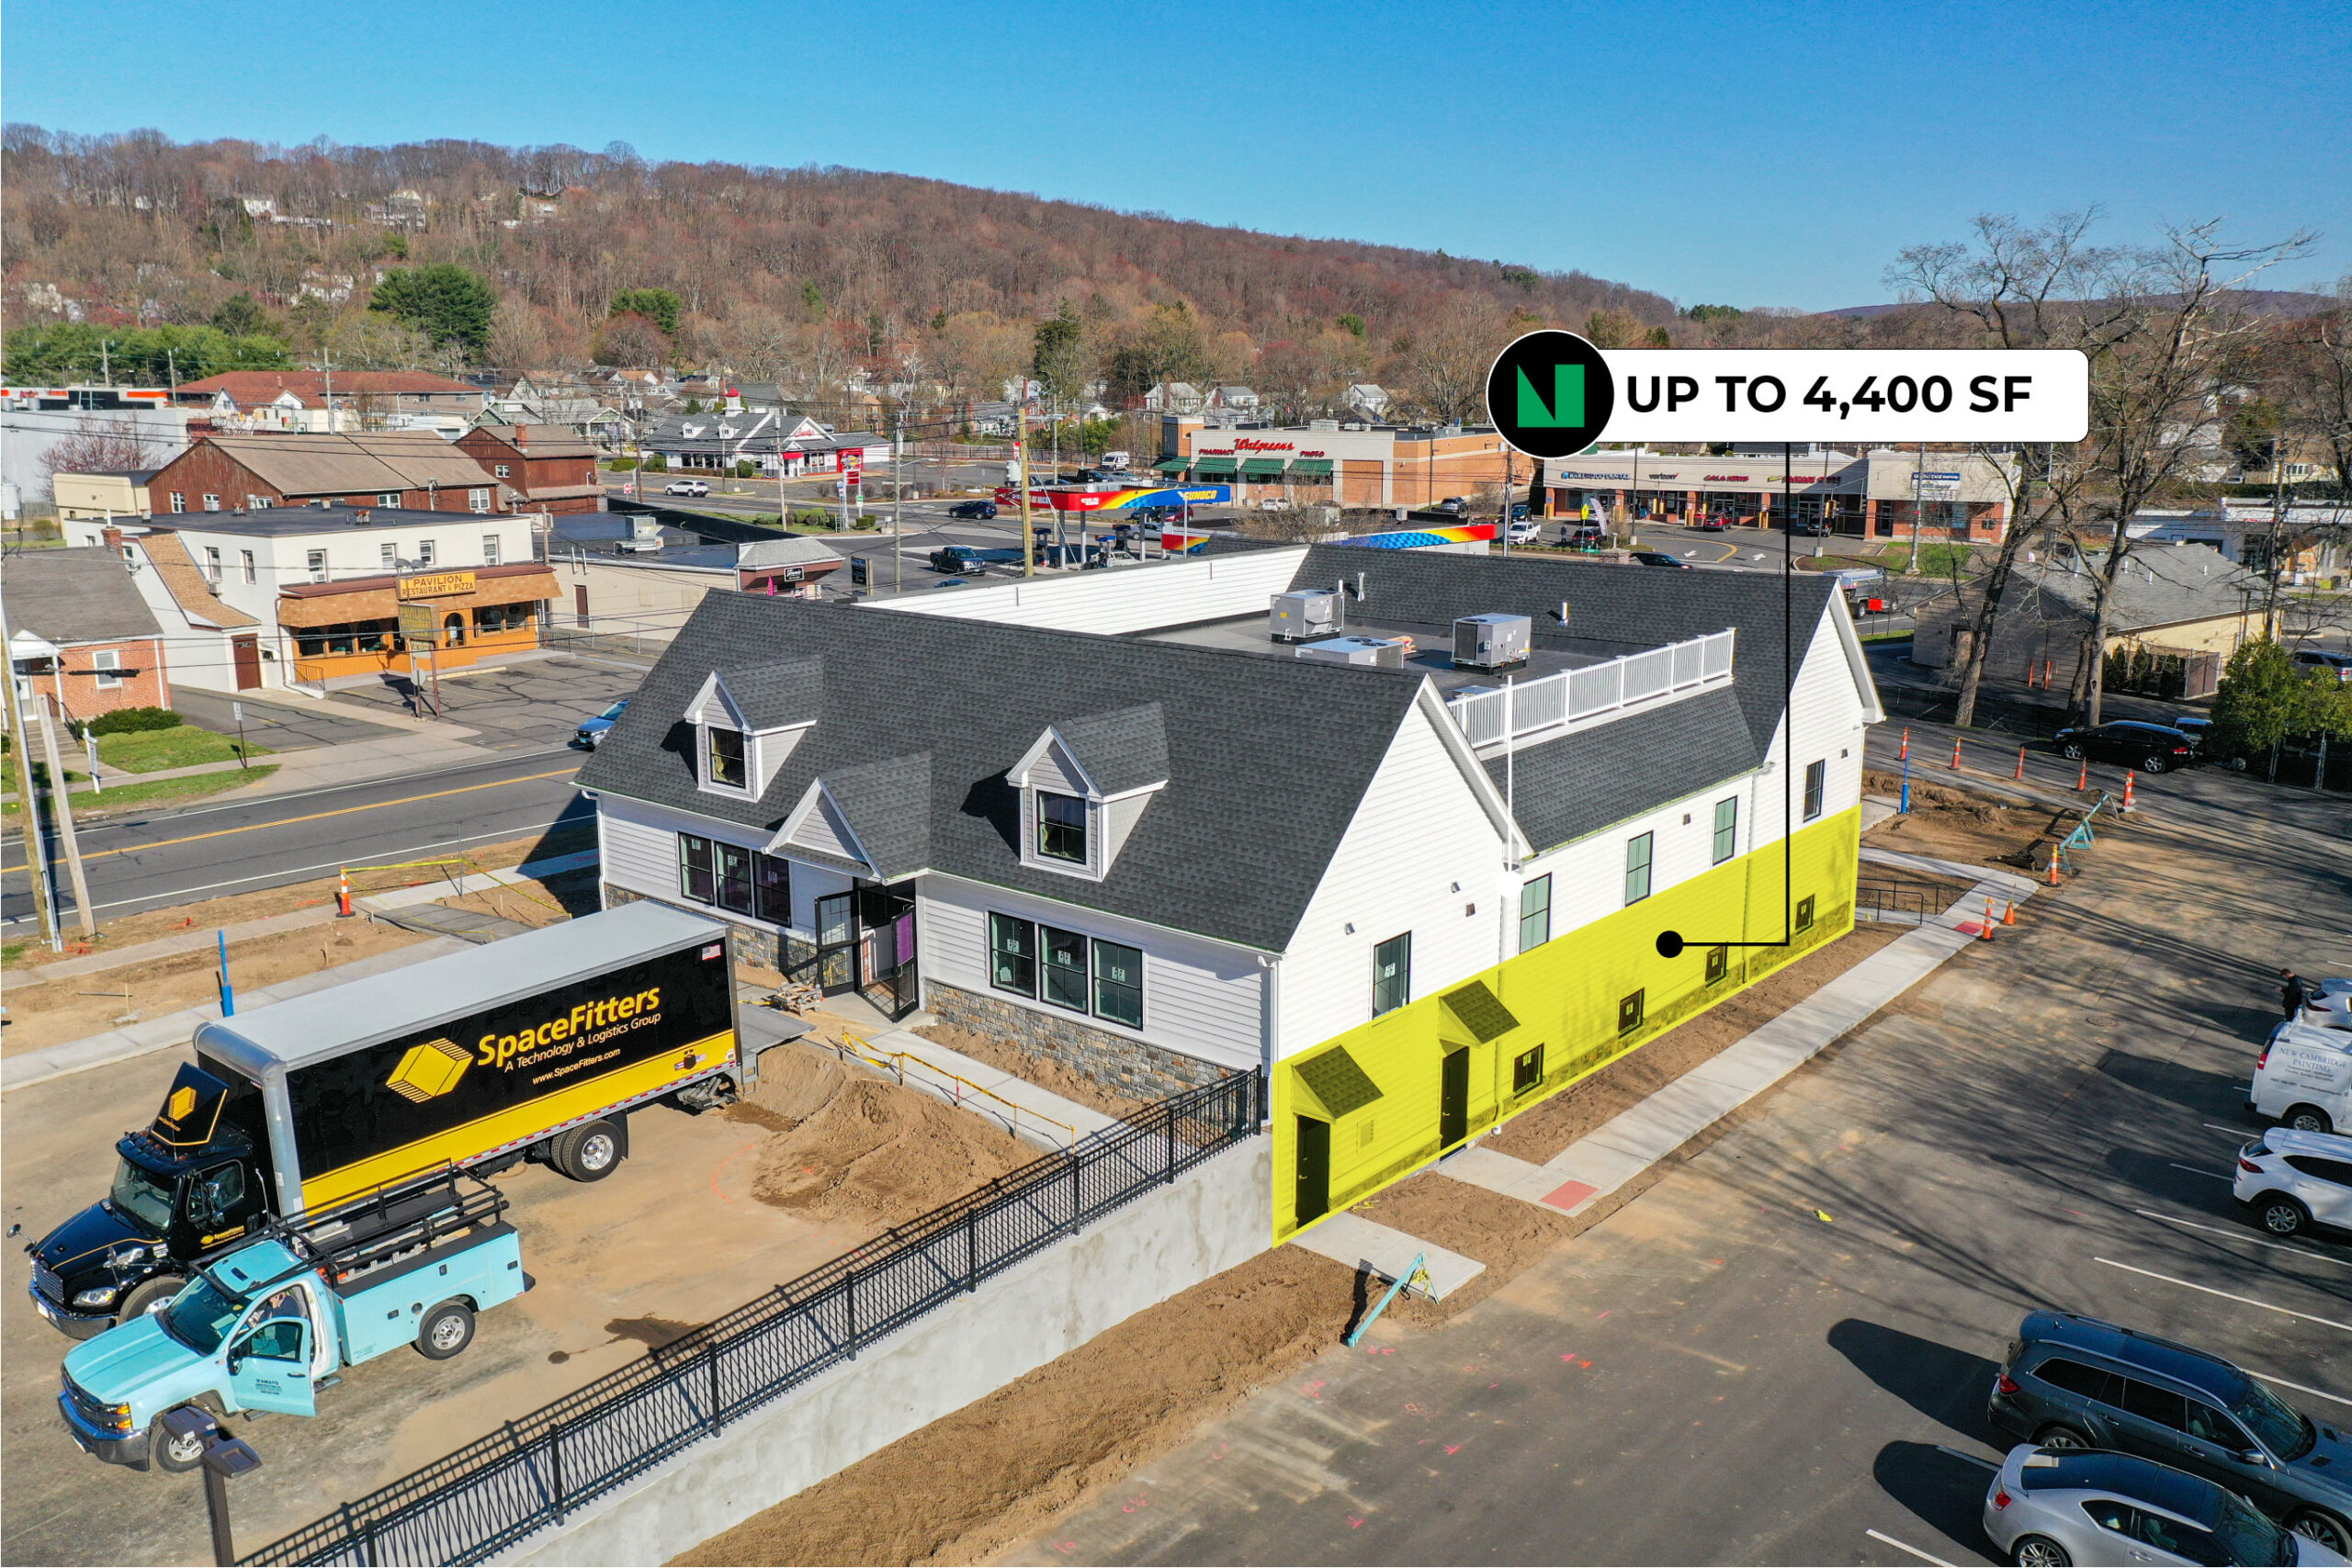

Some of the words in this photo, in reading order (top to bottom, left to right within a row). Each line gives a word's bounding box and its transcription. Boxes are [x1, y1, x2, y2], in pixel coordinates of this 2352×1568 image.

[1234, 437, 1295, 454] Walgreens
[1183, 490, 1218, 501] SUNOCO
[401, 584, 447, 596] RESTAURANT
[454, 581, 474, 592] PIZZA
[413, 574, 462, 588] PAVILION
[477, 987, 661, 1068] SpaceFitters
[503, 1061, 514, 1074] A
[516, 1040, 575, 1069] Technology
[576, 1035, 585, 1047] &
[587, 1021, 629, 1045] Logistics
[630, 1012, 662, 1029] Group
[532, 1046, 621, 1086] www.SpaceFitters.com
[2279, 1047, 2297, 1056] NEW
[2300, 1052, 2346, 1068] CAMBRIDGE
[2293, 1058, 2330, 1073] PAINTING
